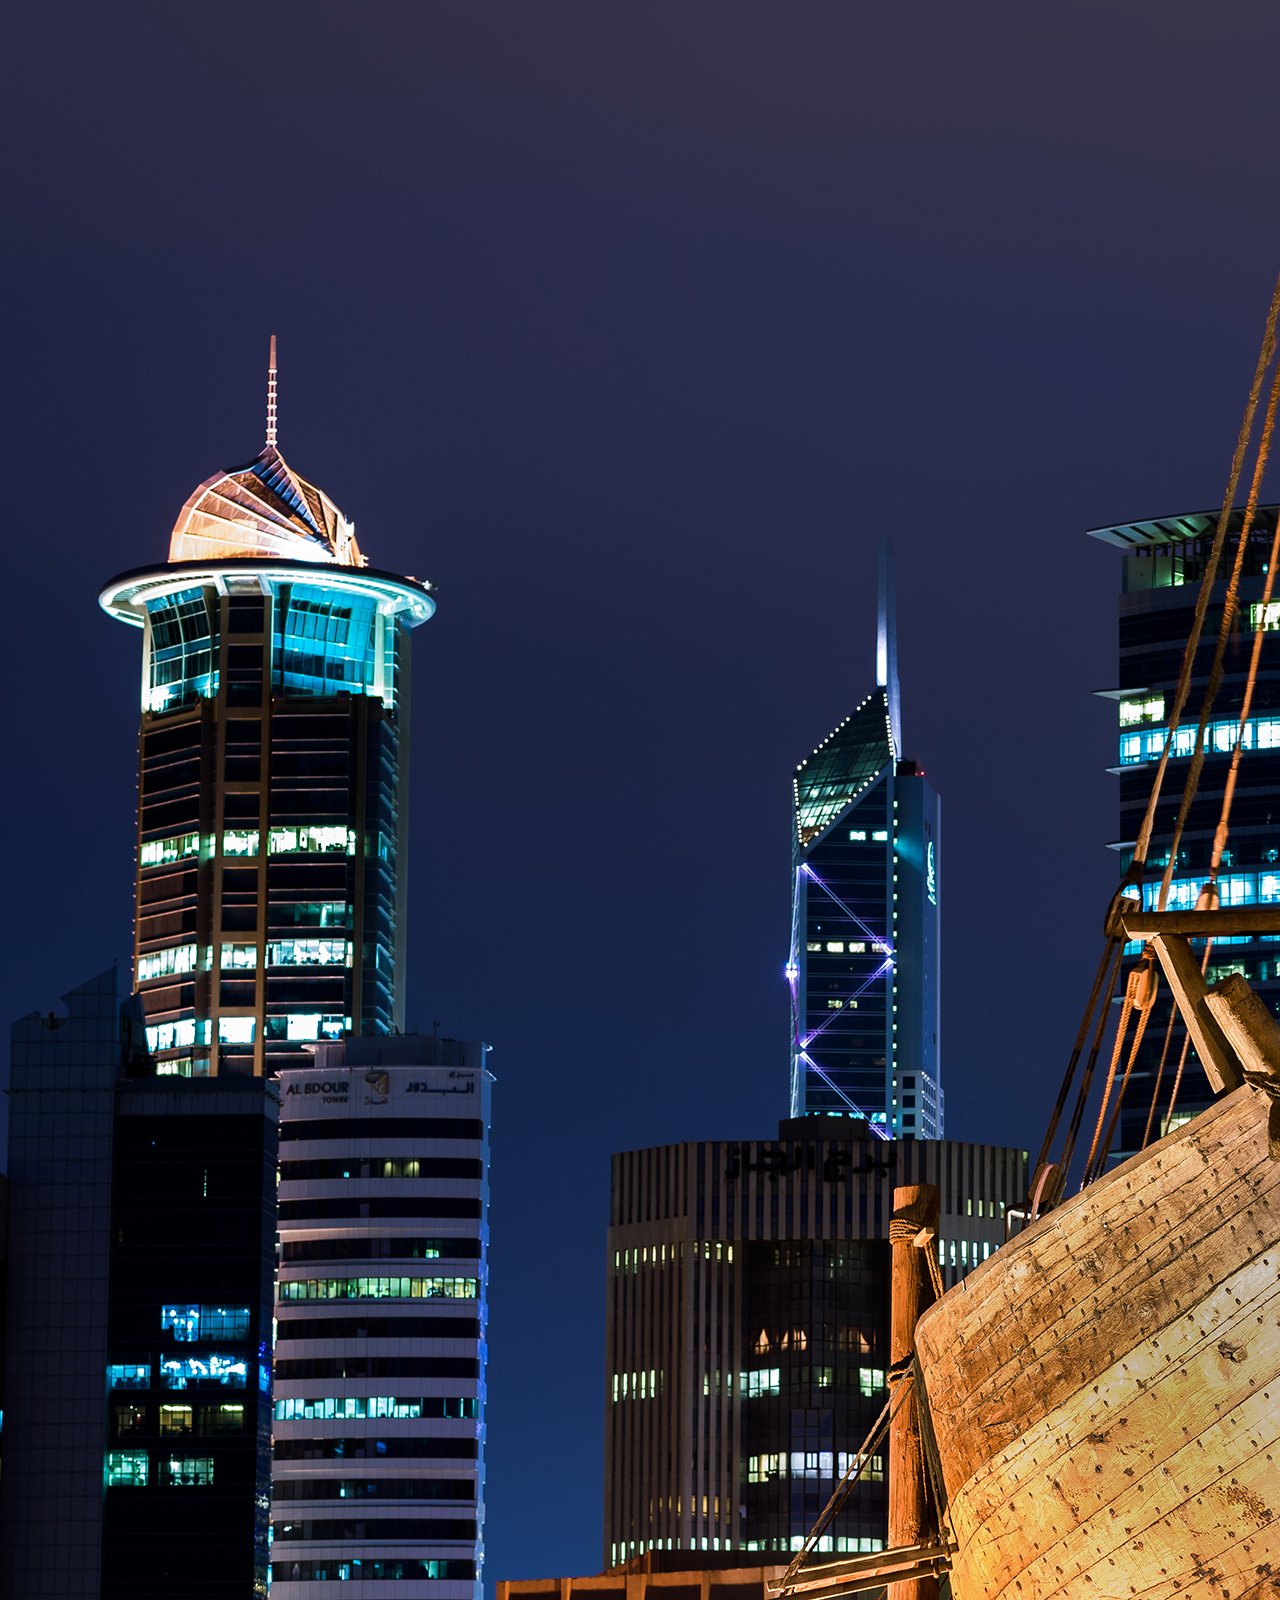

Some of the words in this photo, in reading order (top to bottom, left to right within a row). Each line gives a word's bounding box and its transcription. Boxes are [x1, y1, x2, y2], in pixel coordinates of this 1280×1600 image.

[286, 1083, 302, 1095] AL
[304, 1082, 349, 1094] BDOUR
[322, 1096, 349, 1104] TOWER
